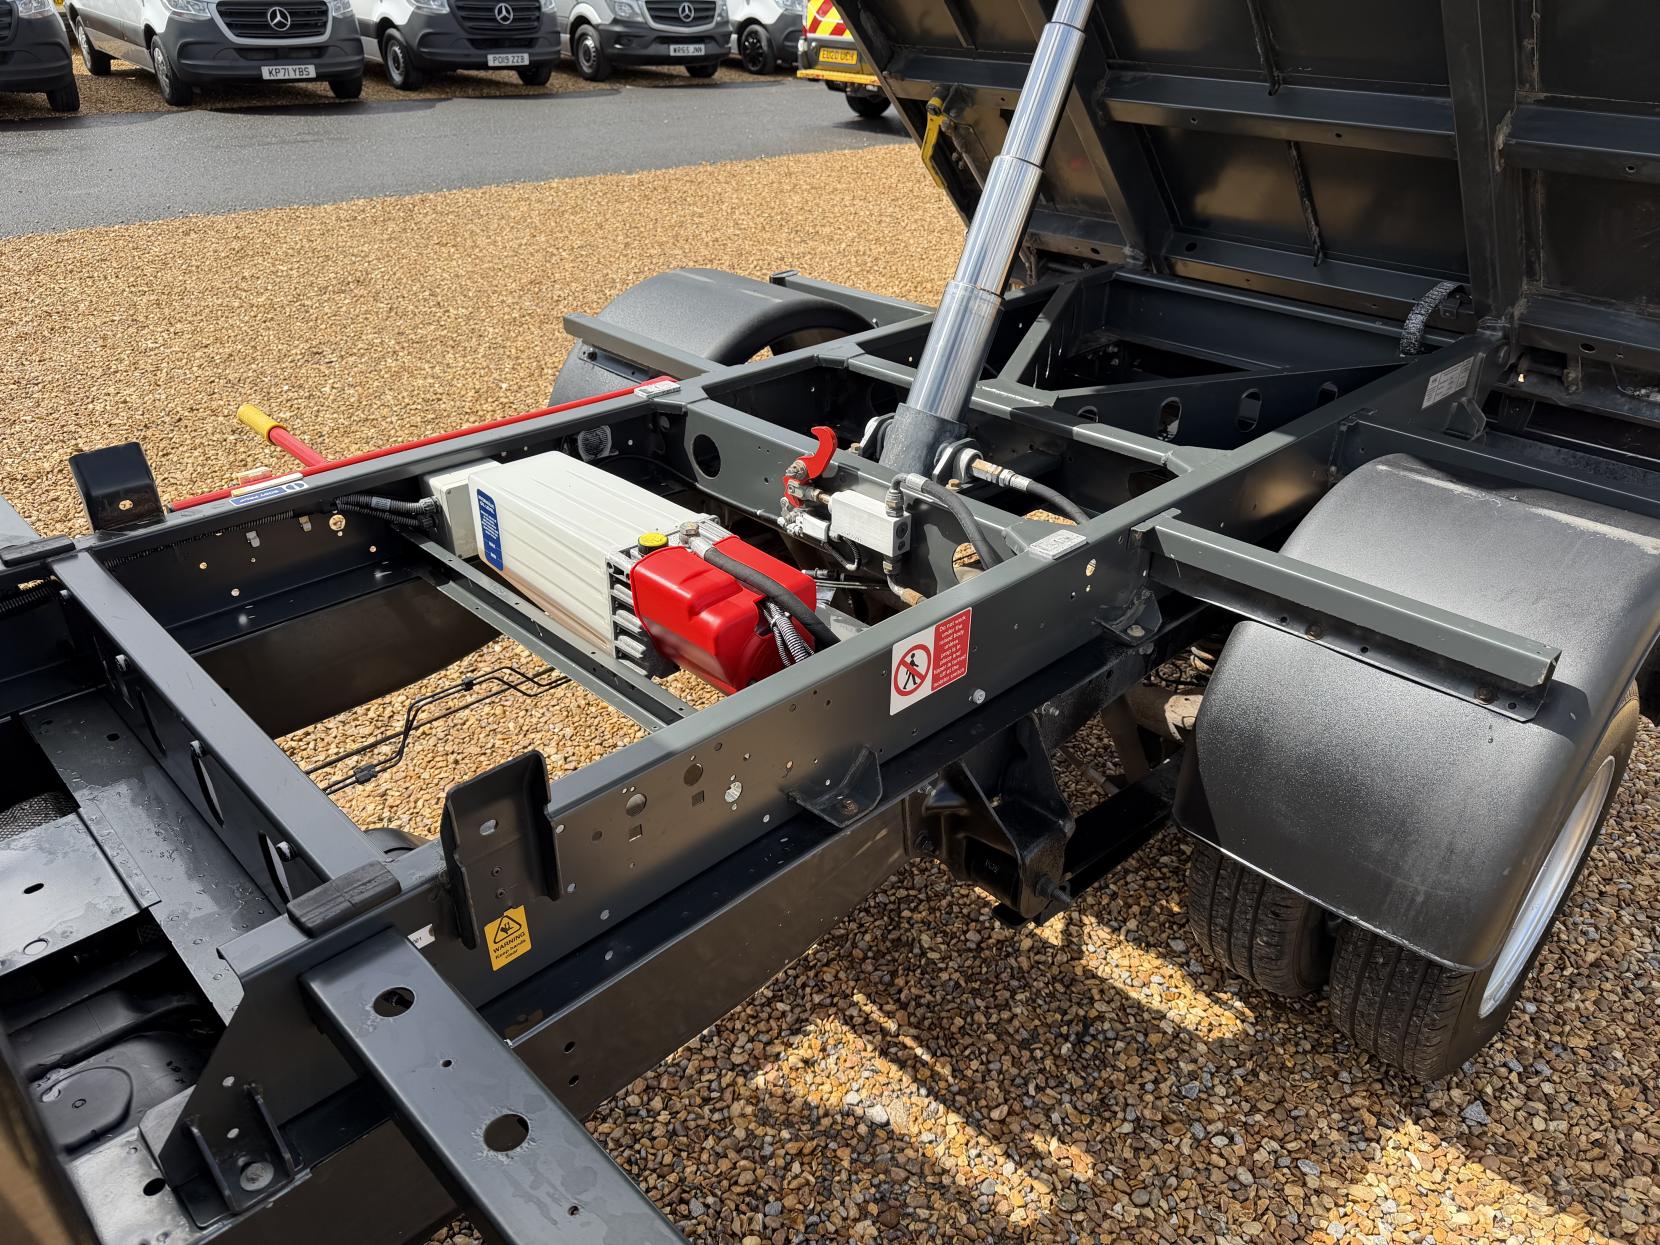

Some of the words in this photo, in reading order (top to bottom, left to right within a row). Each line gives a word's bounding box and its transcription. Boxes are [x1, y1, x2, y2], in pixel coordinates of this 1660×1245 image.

[268, 67, 290, 78] KP71
[291, 67, 310, 77] YBS
[493, 932, 526, 953] WARNING
[495, 949, 509, 960] Keep
